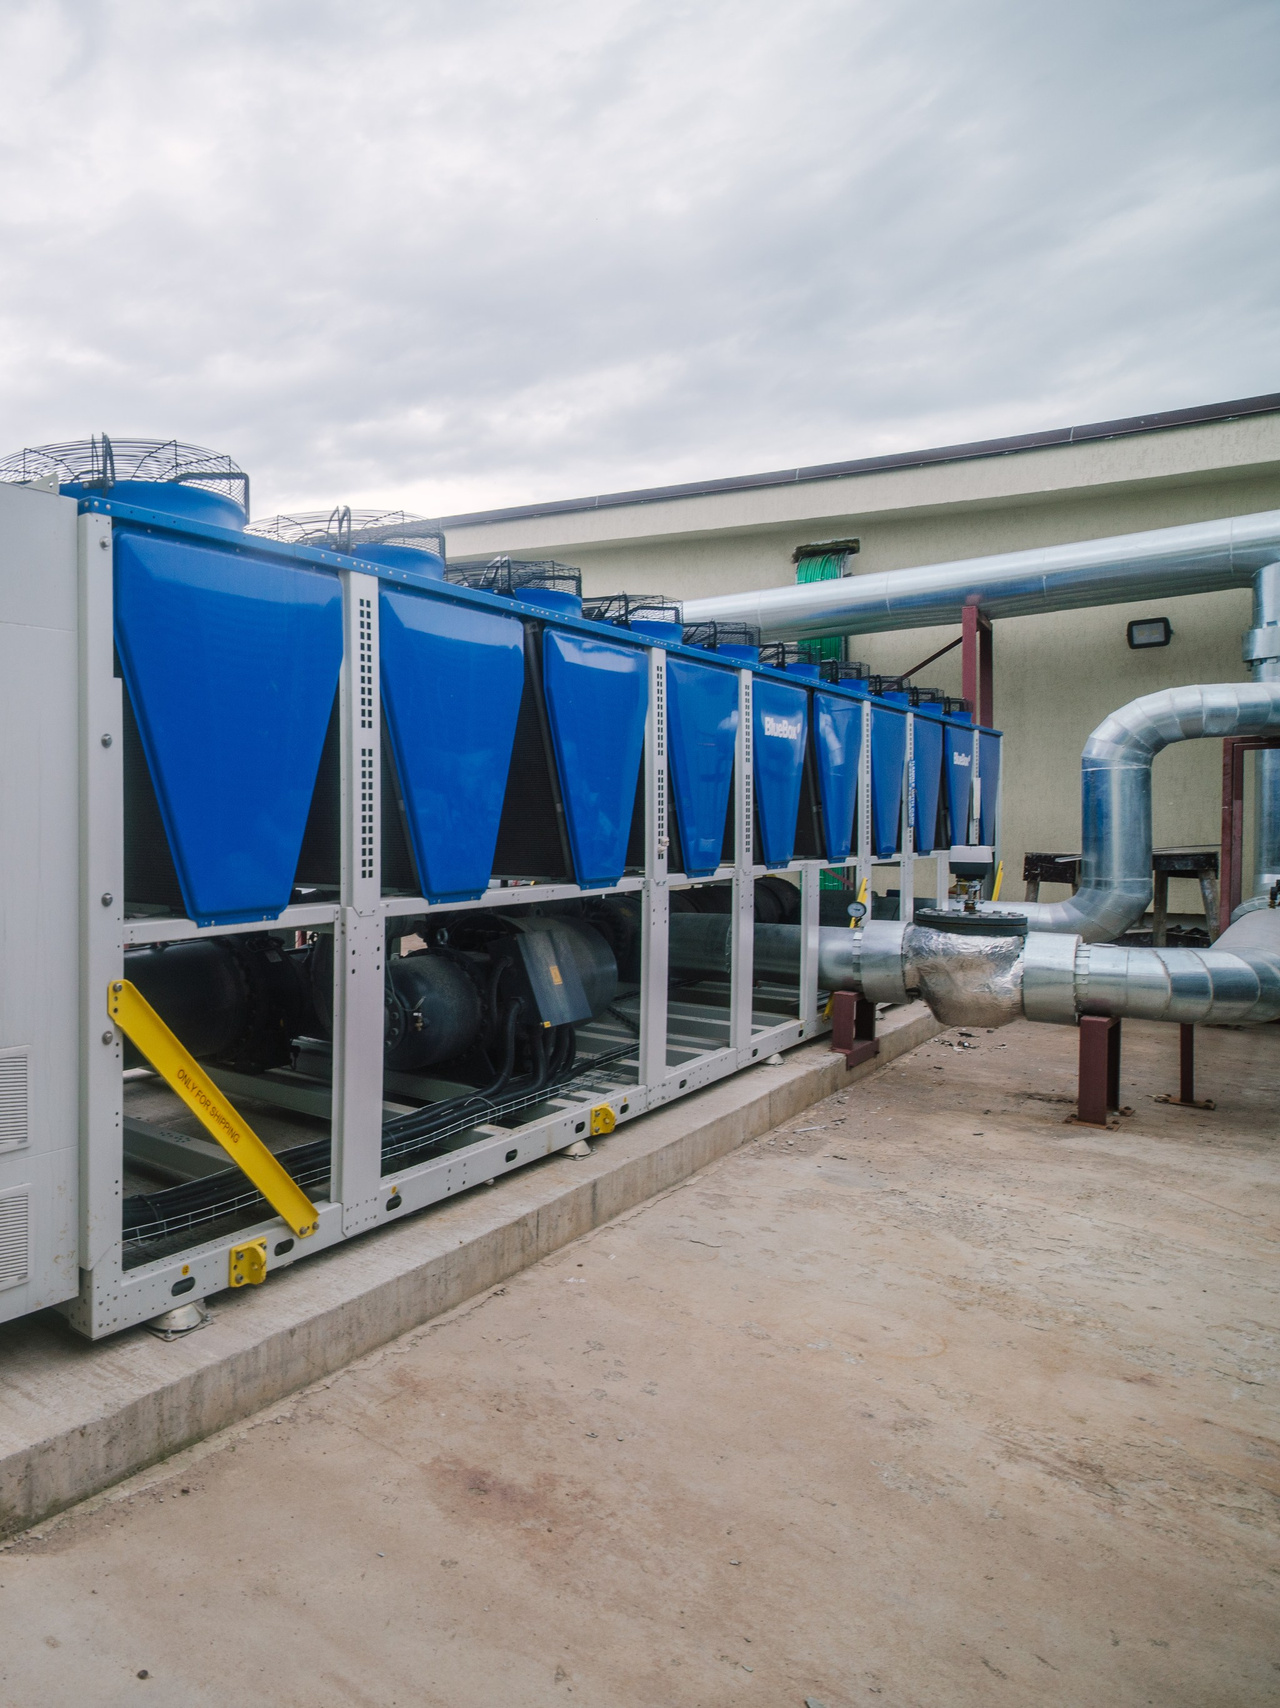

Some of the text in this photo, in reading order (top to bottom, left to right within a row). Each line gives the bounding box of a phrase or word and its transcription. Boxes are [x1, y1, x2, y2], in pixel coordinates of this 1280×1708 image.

[764, 716, 797, 740] BlueBox
[177, 1069, 240, 1144] ONLY FOR SHIPPING
